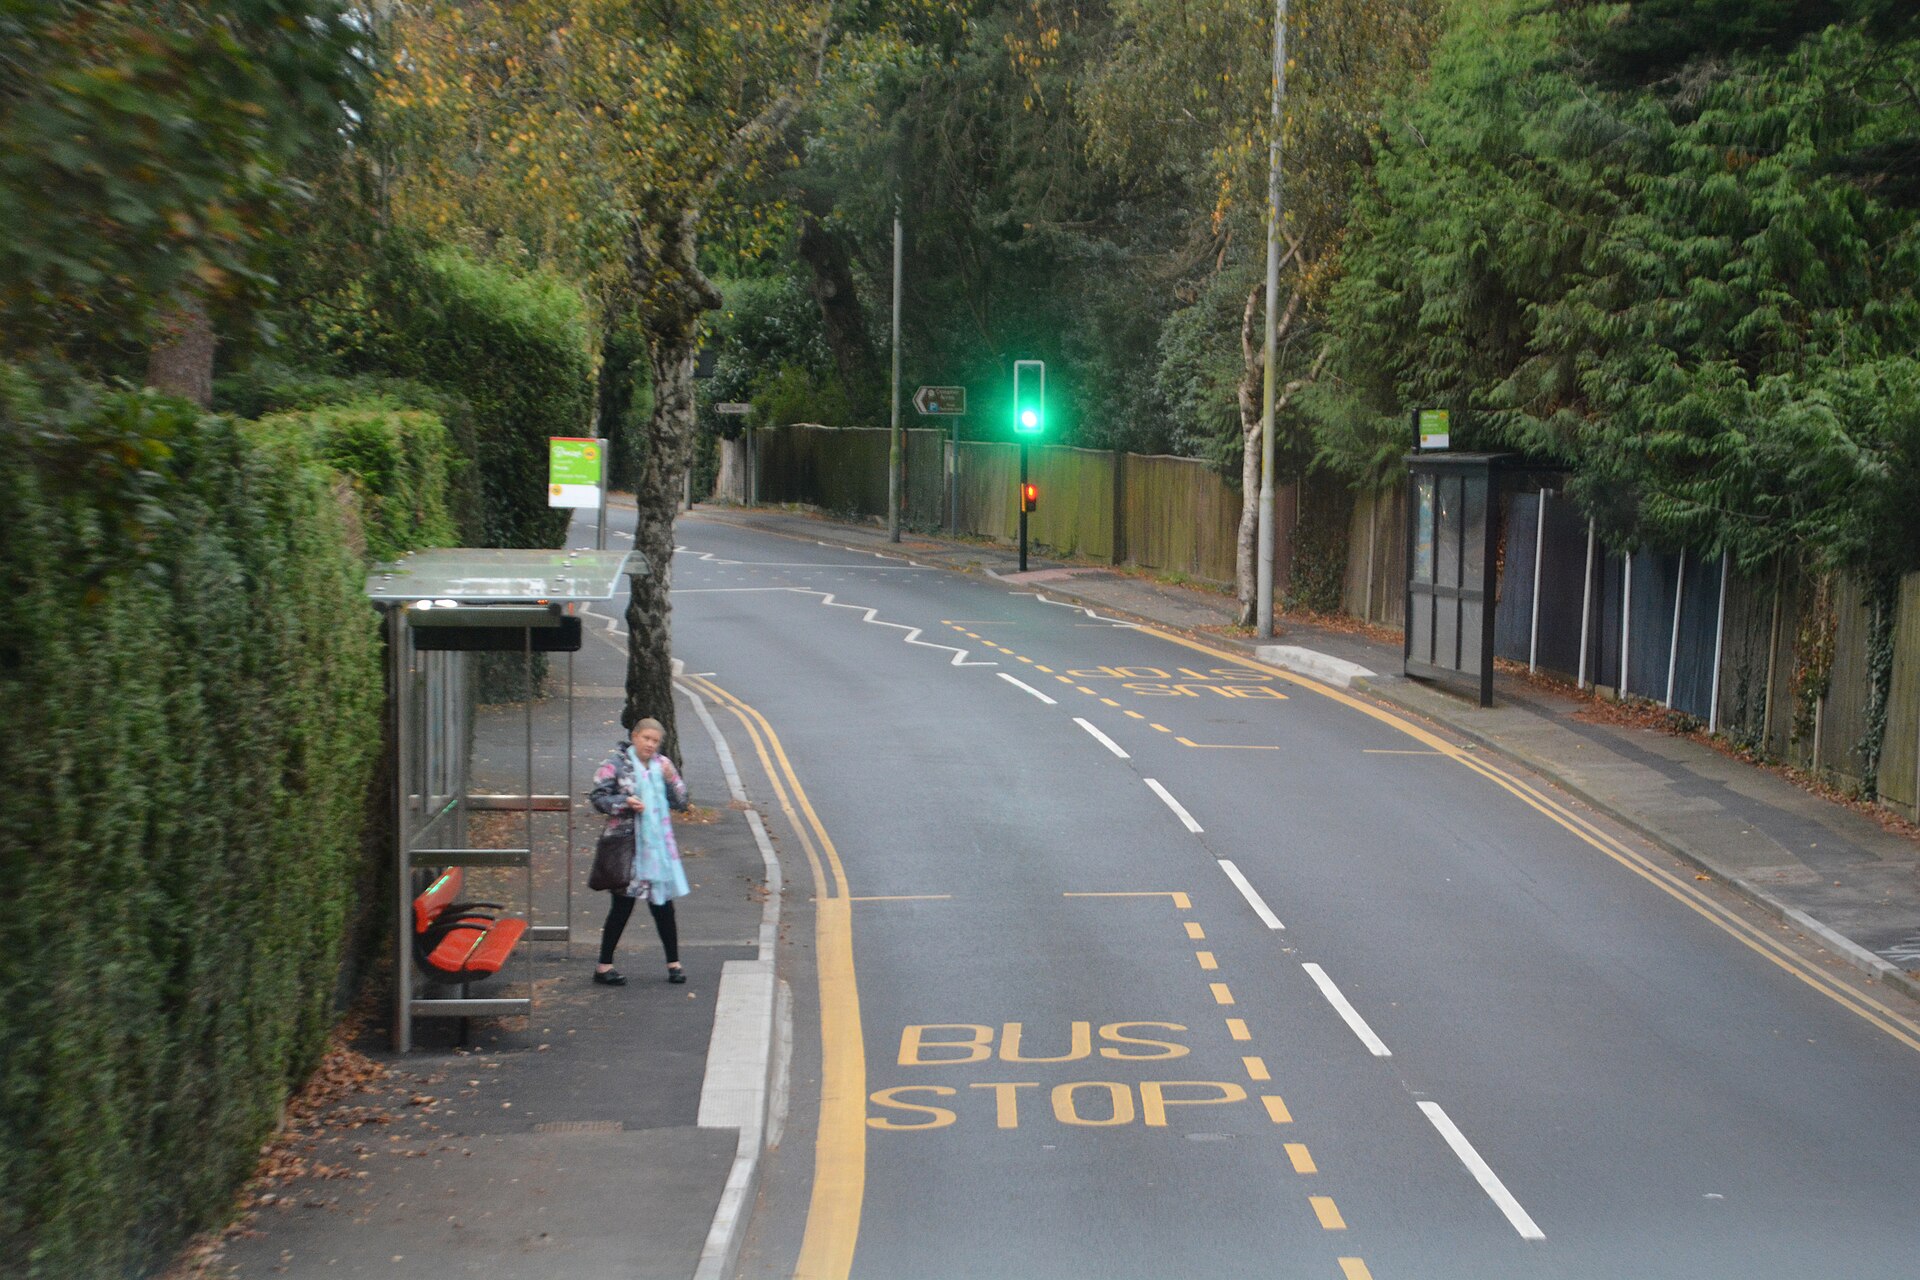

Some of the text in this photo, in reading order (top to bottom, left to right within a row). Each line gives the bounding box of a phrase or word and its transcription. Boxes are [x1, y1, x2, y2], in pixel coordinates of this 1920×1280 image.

[1066, 666, 1273, 681] STOP
[1122, 682, 1289, 699] BUS
[897, 1021, 1190, 1066] BUS
[866, 1081, 1248, 1130] STOP
